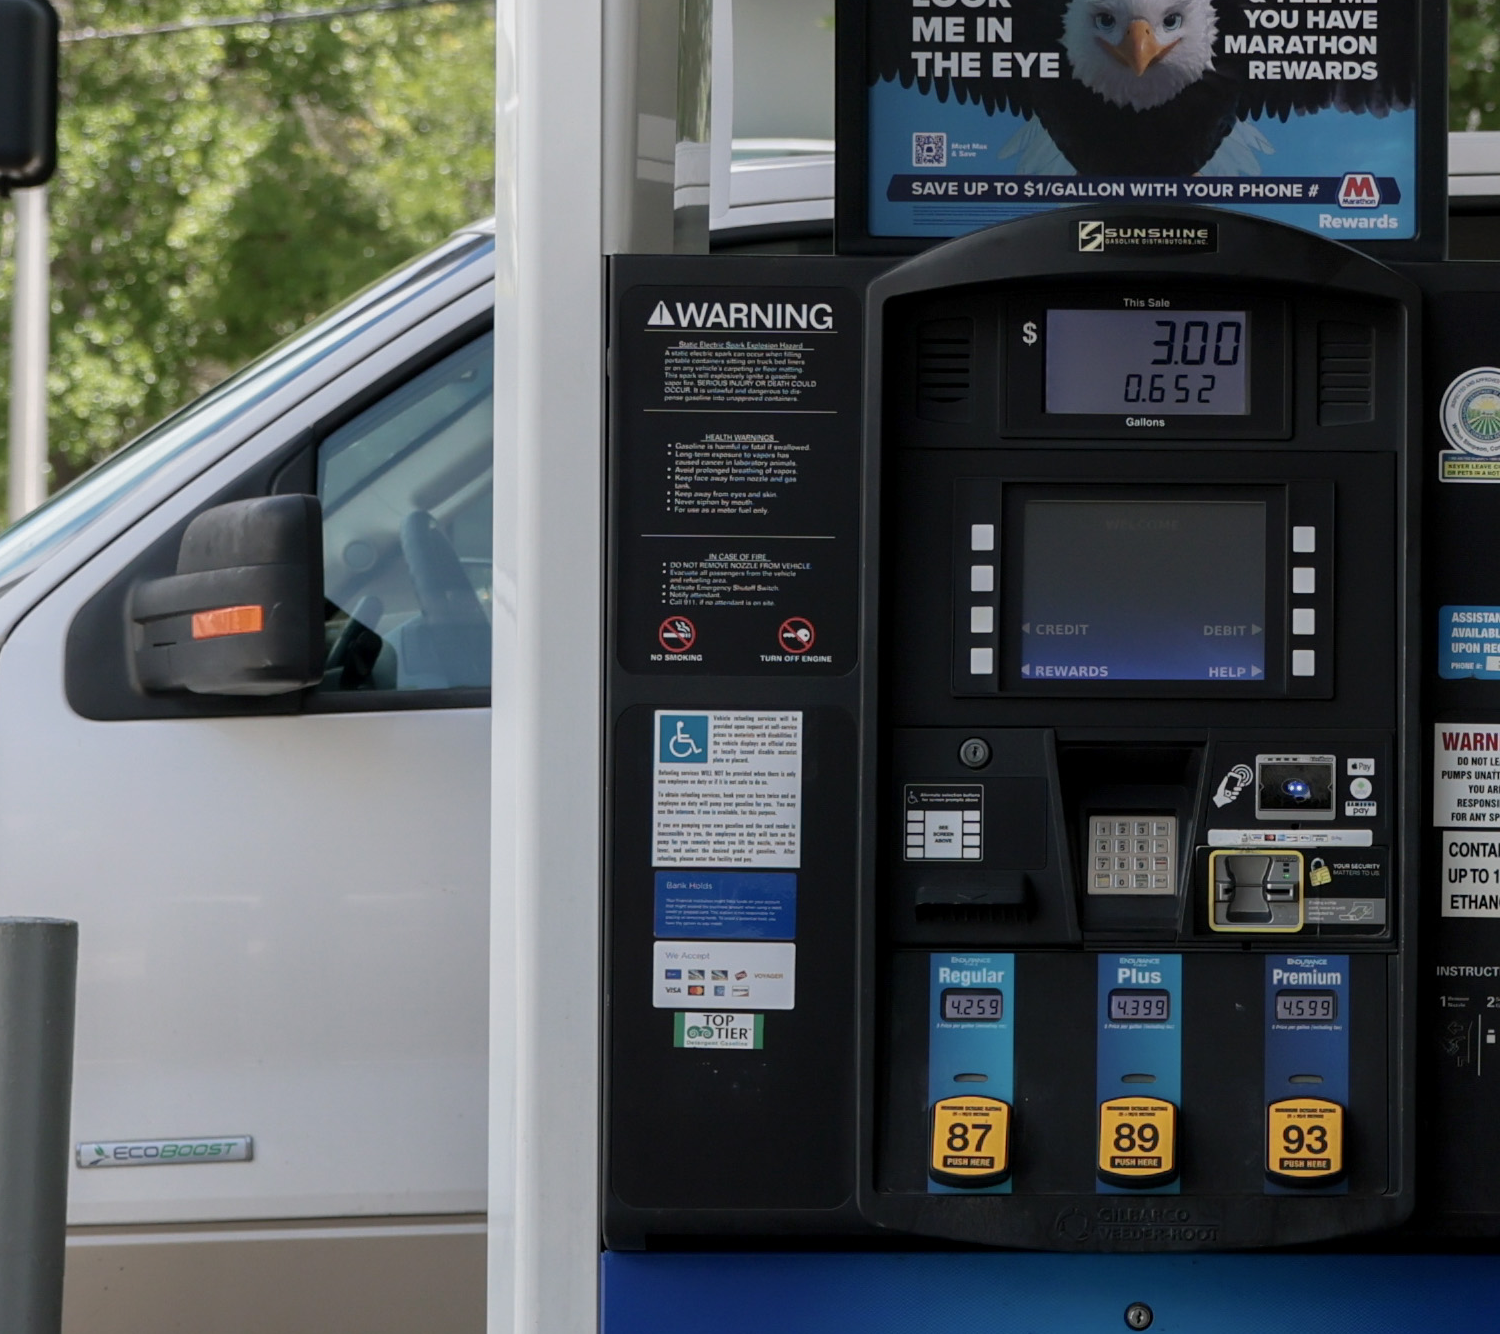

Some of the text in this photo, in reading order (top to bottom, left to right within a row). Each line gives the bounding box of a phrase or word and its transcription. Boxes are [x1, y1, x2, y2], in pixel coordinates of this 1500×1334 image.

[1244, 9, 1378, 29] YOU HAVE
[913, 16, 1012, 43] ME IN
[1225, 35, 1377, 55] MARATHON
[911, 52, 1060, 78] THE EYE
[1249, 61, 1378, 80] REWARDS
[912, 181, 1319, 197] SAVE UP TO $1/GALLON WITH YOUR PHONE #
[1345, 178, 1374, 195] M
[1342, 196, 1376, 205] Marathon
[1319, 214, 1398, 228] Rewards
[1105, 228, 1208, 238] SUNSHINE
[1123, 298, 1170, 307] This Sale
[676, 302, 833, 329] WARNING
[1022, 321, 1037, 346] $
[1151, 320, 1242, 366] 3.00
[1124, 374, 1215, 403] 0.652
[1126, 417, 1165, 427] Gallons
[1036, 624, 1089, 635] CREDIT
[1204, 625, 1246, 636] DEBIT
[1452, 643, 1480, 653] UPON
[1036, 666, 1108, 677] REWARDS
[1209, 667, 1246, 677] HELP
[1359, 763, 1371, 771] Pay
[1457, 756, 1469, 766] DO
[1471, 757, 1488, 766] NOT
[1441, 770, 1472, 780] PUMPS
[1468, 785, 1485, 794] YOU
[1451, 812, 1467, 821] FOR
[1469, 813, 1486, 821] ANY
[1448, 868, 1468, 884] UP
[1470, 868, 1489, 884] TO
[681, 952, 710, 960] Accept
[939, 968, 1005, 986] Regular
[1118, 968, 1161, 984] Plus
[1273, 969, 1341, 985] Premium
[952, 999, 999, 1015] 4.259
[1118, 1000, 1165, 1016] 4.399
[1283, 1000, 1330, 1016] 4.599
[1440, 996, 1446, 1007] 1
[1487, 996, 1495, 1007] 2
[703, 1015, 734, 1026] TOP
[715, 1028, 748, 1039] TIER
[947, 1123, 992, 1152] 87
[1113, 1123, 1159, 1152] 89
[1283, 1125, 1328, 1154] 93
[1115, 1158, 1136, 1166] PUSH
[1307, 1160, 1327, 1168] HERE
